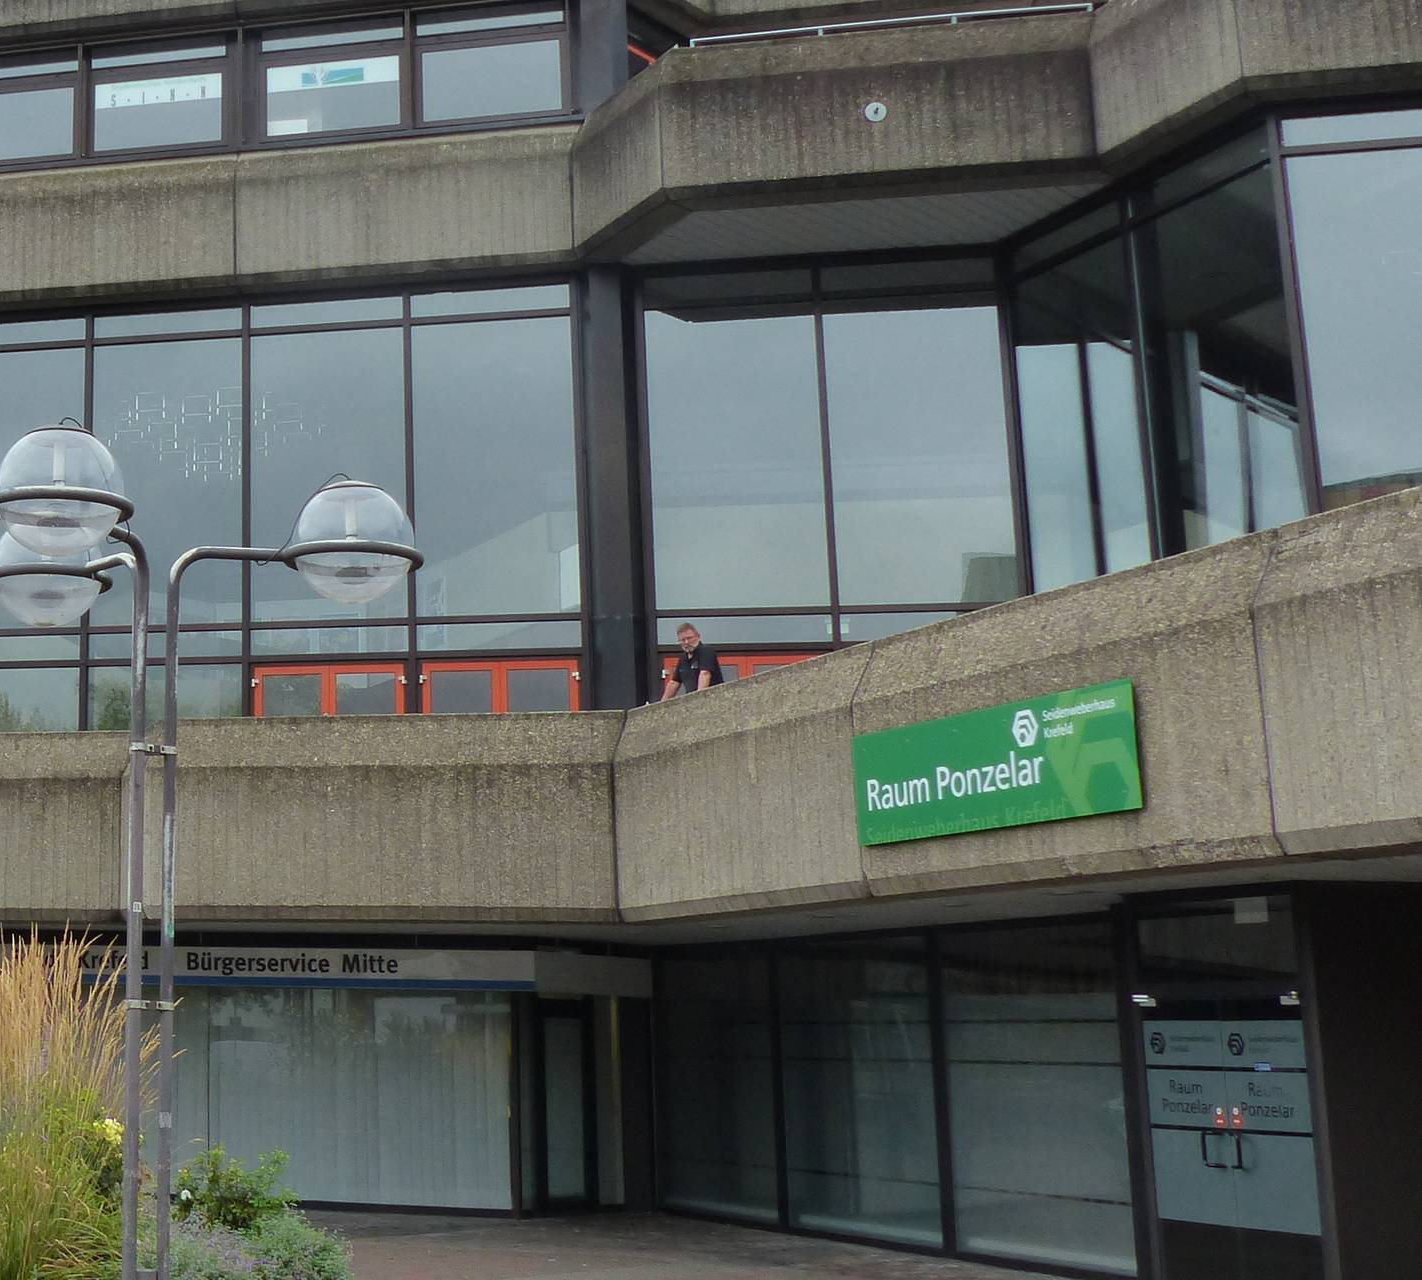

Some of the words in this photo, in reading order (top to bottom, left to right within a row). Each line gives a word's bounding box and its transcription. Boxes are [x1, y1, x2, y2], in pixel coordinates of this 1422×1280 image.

[1041, 698, 1116, 721] Seidenweberhaus
[1043, 722, 1074, 738] Krefeld
[866, 776, 930, 811] Raum
[936, 751, 1044, 800] Ponzelar
[187, 952, 330, 976] Bürgerservice
[342, 953, 399, 973] Mitte
[1169, 1080, 1203, 1096] Raum
[1162, 1098, 1214, 1114] Ponzelar
[1240, 1102, 1295, 1119] Ponzelar
